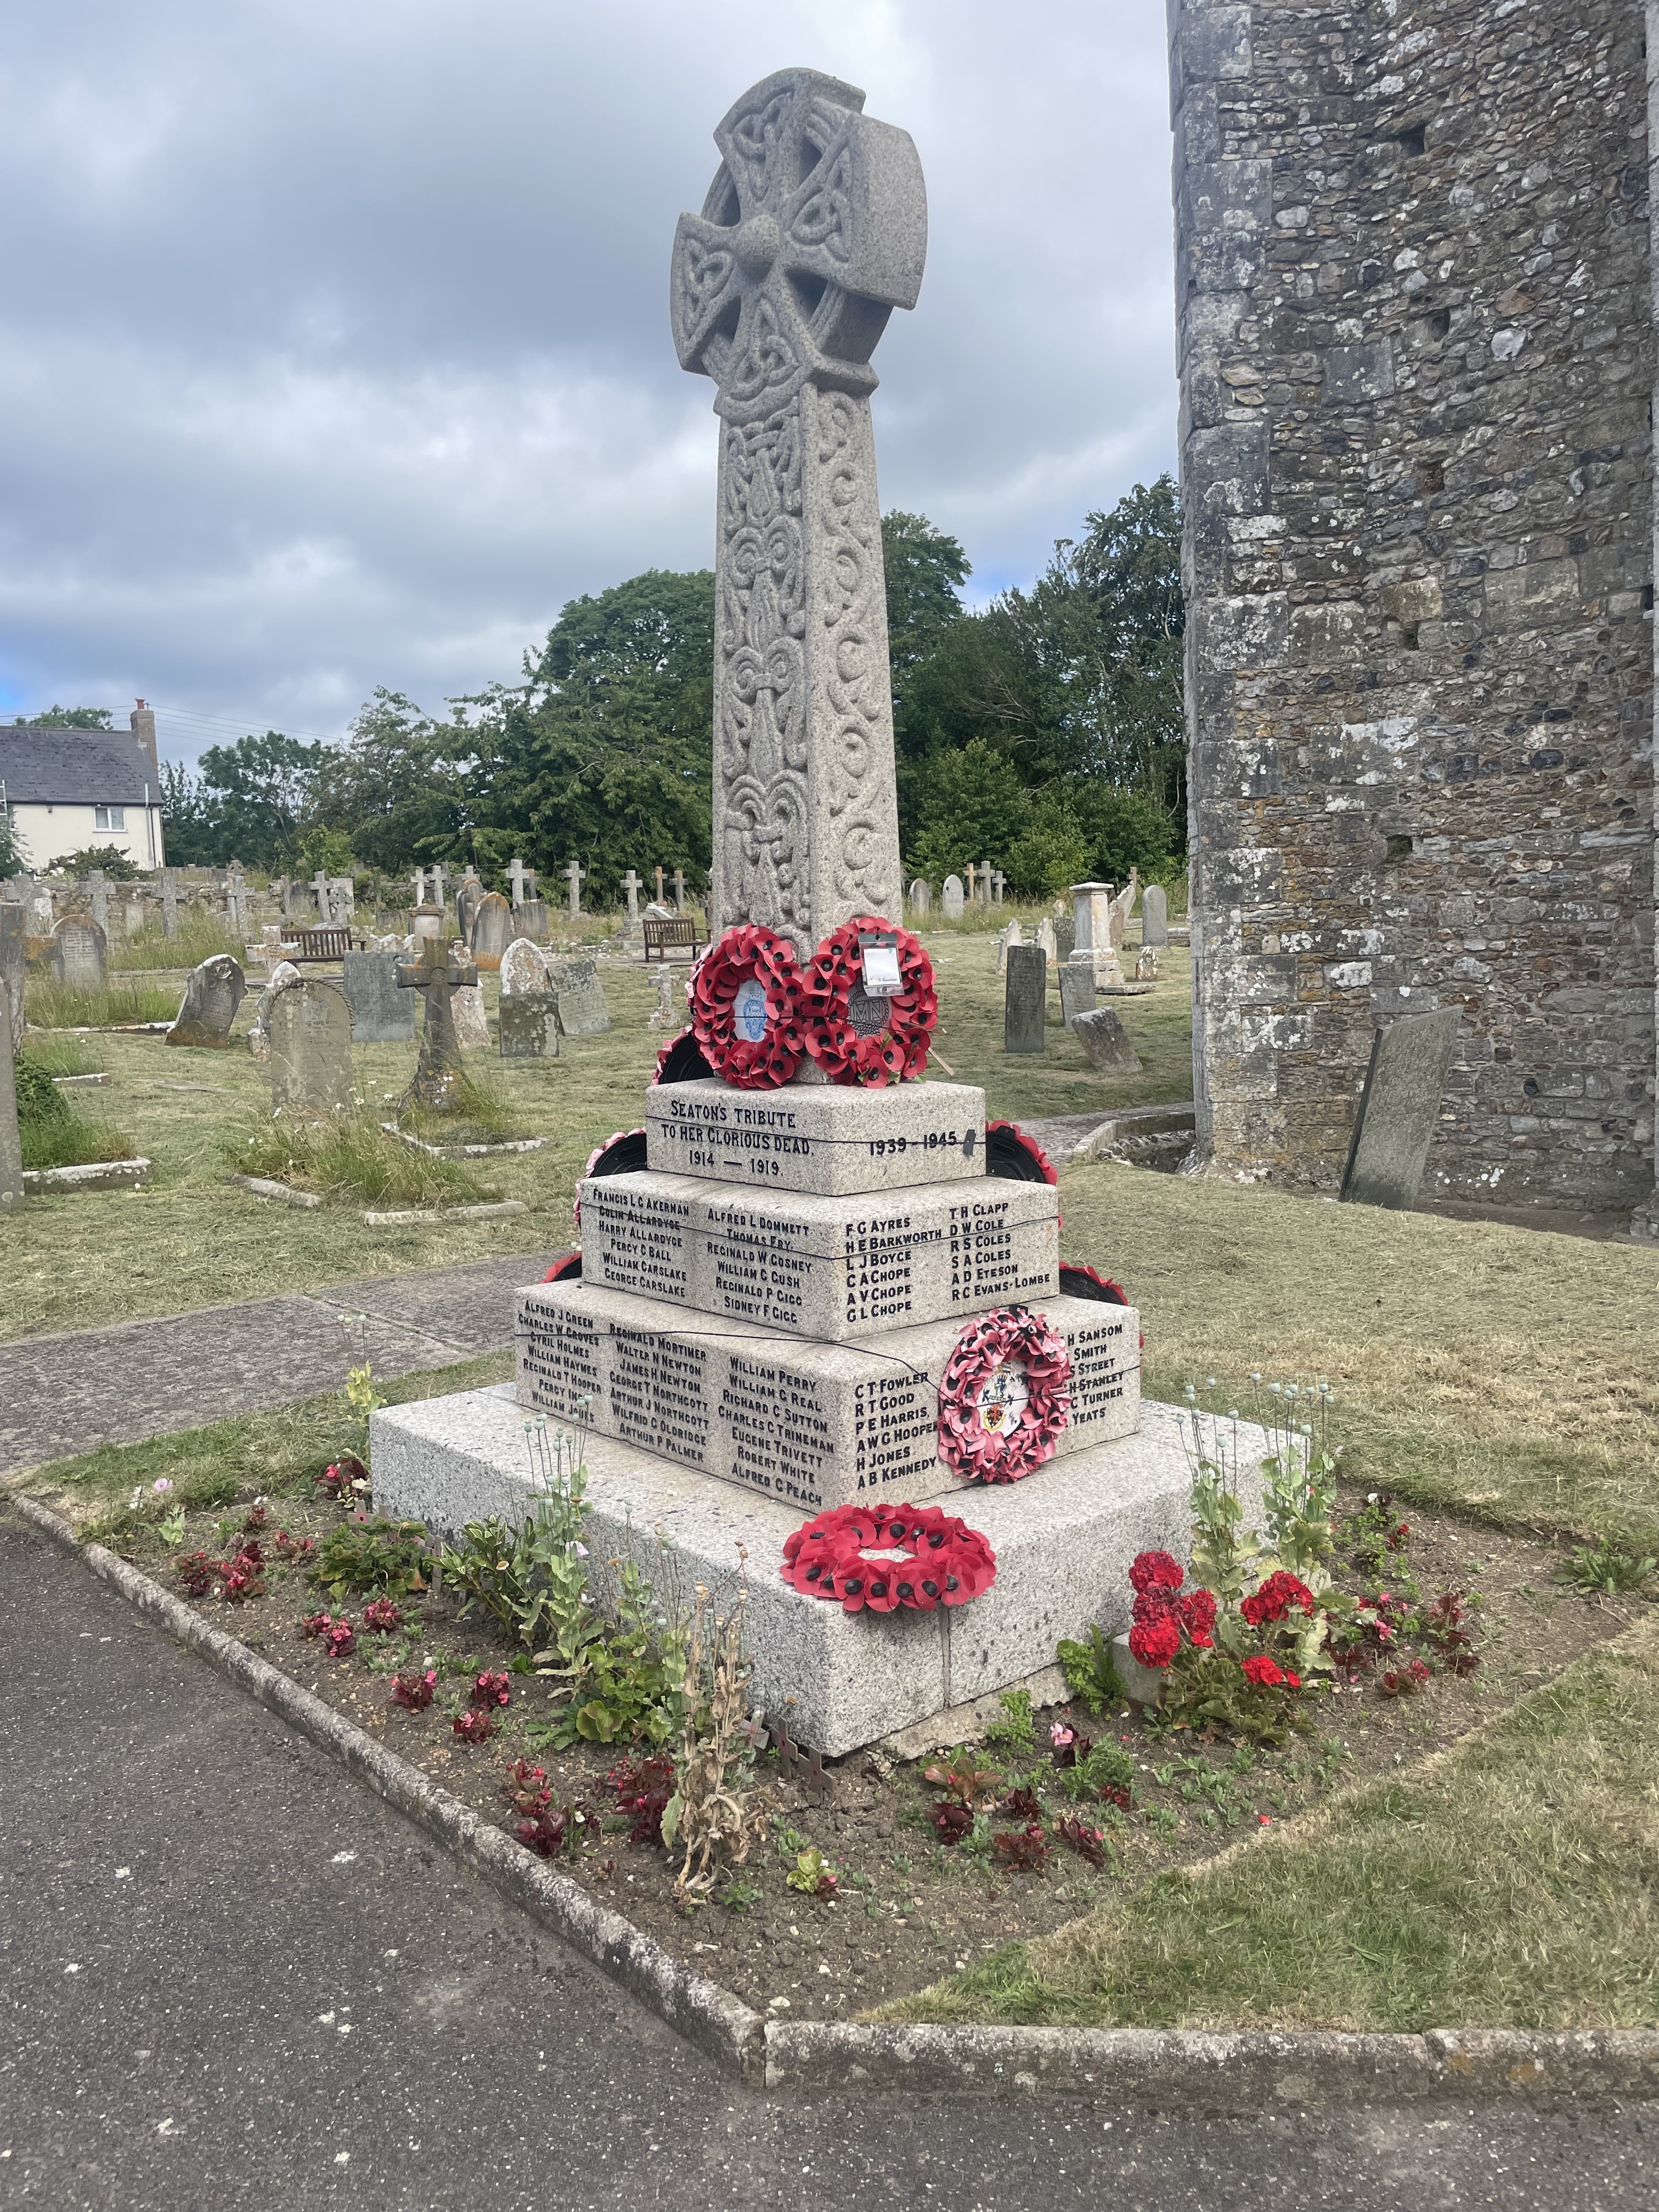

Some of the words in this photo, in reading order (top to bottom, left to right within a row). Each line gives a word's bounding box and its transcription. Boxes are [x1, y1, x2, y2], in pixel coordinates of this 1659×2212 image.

[850, 1000, 885, 1022] MN
[671, 1100, 727, 1121] SEATON'S
[735, 1108, 796, 1128] TRIBUTE
[662, 1124, 676, 1138] TO
[680, 1126, 704, 1142] HER
[708, 1127, 770, 1150] GLORIOUS
[774, 1136, 815, 1156] DEAD.
[870, 1137, 906, 1156] 1939
[923, 1131, 957, 1149] 1945
[689, 1150, 715, 1167] 1914
[594, 1189, 628, 1205] FRANCIS
[631, 1195, 635, 1206] L
[647, 1198, 689, 1216] AKERMAN
[950, 1208, 957, 1220] T
[961, 1207, 968, 1218] H
[973, 1203, 1008, 1216] CLAPP
[599, 1205, 623, 1220] COLIN
[628, 1211, 680, 1230] ALLARDYCE
[708, 1208, 746, 1225] ALFRED
[751, 1215, 756, 1227] L
[760, 1217, 809, 1236] DOMMETT
[846, 1224, 853, 1237] F
[858, 1222, 866, 1234] G
[871, 1217, 911, 1233] AYRES
[950, 1225, 957, 1236] D
[975, 1220, 1003, 1232] COLE
[599, 1220, 626, 1237] HARRY
[630, 1227, 682, 1247] ALLARDYCE
[727, 1228, 766, 1245] THOMAS
[846, 1241, 854, 1253] H
[859, 1239, 866, 1251] E
[870, 1229, 942, 1250] BARKWORTH
[951, 1240, 959, 1252] R
[963, 1238, 970, 1249] S
[976, 1233, 1011, 1248] COLES
[611, 1238, 637, 1254] PERCY
[649, 1246, 671, 1261] BALL
[708, 1242, 755, 1261] REGINALD
[758, 1251, 767, 1264] W
[847, 1258, 854, 1271] L
[860, 1256, 866, 1268] J
[870, 1251, 911, 1266] BOYCE
[952, 1256, 958, 1268] S
[964, 1255, 972, 1267] A
[975, 1249, 1011, 1264] COLES
[603, 1252, 639, 1271] WILLIAM
[641, 1261, 686, 1282] CARSLAKE
[718, 1261, 757, 1280] WILLIAM
[847, 1274, 855, 1288] C
[860, 1273, 868, 1285] A
[871, 1267, 911, 1283] CHOPE
[952, 1273, 959, 1285] A
[964, 1271, 971, 1283] D
[977, 1265, 1018, 1280] ETESON
[605, 1268, 636, 1285] GEORGE
[640, 1277, 685, 1297] CARSLAKE
[716, 1277, 762, 1297] REGINALD
[766, 1288, 772, 1299] P
[847, 1293, 855, 1305] A
[860, 1290, 868, 1302] V
[871, 1285, 911, 1300] CHOPE
[952, 1289, 960, 1301] R
[963, 1286, 969, 1299] C
[974, 1274, 1050, 1296] EVANS-LOMBE
[526, 1300, 555, 1318] ALFRED
[558, 1310, 562, 1320] J
[566, 1312, 593, 1329] GREEN
[724, 1295, 760, 1315] SIDNEY
[764, 1304, 769, 1317] F
[847, 1310, 856, 1322] G
[861, 1307, 868, 1319] L
[871, 1301, 912, 1317] CHOPE
[519, 1314, 553, 1333] CHARLES
[556, 1323, 563, 1335] W
[567, 1327, 599, 1346] GROVES
[610, 1323, 654, 1346] REGINALD
[658, 1337, 707, 1361] MORTIMER
[1068, 1334, 1074, 1346] H
[1079, 1324, 1122, 1343] SANSOM
[531, 1331, 554, 1347] CYRIL
[557, 1339, 589, 1358] HOLMES
[1074, 1344, 1107, 1361] SMITH
[528, 1345, 561, 1365] WILLIAM
[564, 1357, 597, 1376] HAYMES
[616, 1341, 649, 1361] WALTER
[653, 1352, 658, 1364] N
[662, 1355, 701, 1375] NEWTON
[1079, 1358, 1115, 1375] STREET
[523, 1358, 561, 1379] REGINALD
[564, 1372, 569, 1383] T
[571, 1374, 601, 1393] HOOPER
[620, 1359, 649, 1377] JAMES
[651, 1368, 657, 1380] H
[661, 1370, 700, 1393] NEWTON
[730, 1356, 775, 1381] WILLIAM
[779, 1370, 816, 1392] PERRY
[855, 1385, 864, 1398] C
[867, 1381, 876, 1395] T
[881, 1372, 928, 1393] FOWLER
[1069, 1381, 1076, 1394] H
[1079, 1372, 1123, 1391] STANLEY
[539, 1379, 565, 1396] PERCY
[610, 1371, 642, 1391] GEORGE
[644, 1381, 650, 1393] T
[653, 1384, 708, 1412] NORTHCOTT
[730, 1374, 775, 1398] WILLIAM
[792, 1392, 821, 1412] REAL
[1082, 1387, 1123, 1406] TURNER
[532, 1391, 564, 1412] WILLIAM
[611, 1387, 643, 1408] ARTHUR
[646, 1400, 651, 1410] J
[654, 1402, 709, 1429] NORTHCOTT
[724, 1389, 768, 1414] RICHARD
[785, 1408, 827, 1432] SUTTON
[855, 1403, 864, 1417] R
[868, 1400, 876, 1413] T
[880, 1393, 914, 1410] GOOD
[612, 1403, 647, 1425] WILFRID
[660, 1420, 706, 1446] OLDRIDGE
[856, 1421, 864, 1435] P
[868, 1418, 876, 1431] E
[1073, 1407, 1106, 1425] YEATS
[718, 1406, 764, 1430] CHARLES
[777, 1424, 834, 1453] TRINEMAN
[620, 1423, 654, 1445] ARTHUR
[666, 1438, 703, 1462] PALMER
[732, 1426, 770, 1451] EUGENE
[774, 1440, 822, 1468] TRIVETT
[857, 1440, 865, 1453] A
[868, 1436, 878, 1449] W
[882, 1432, 890, 1445] G
[738, 1446, 776, 1470] ROBERT
[781, 1460, 815, 1483] WHITE
[857, 1457, 865, 1471] H
[869, 1446, 910, 1467] JONES
[732, 1463, 770, 1487] ALFRED
[787, 1483, 821, 1506] PEACH
[857, 1475, 865, 1489] A
[869, 1472, 877, 1486] B
[882, 1457, 936, 1482] KENNEDY
